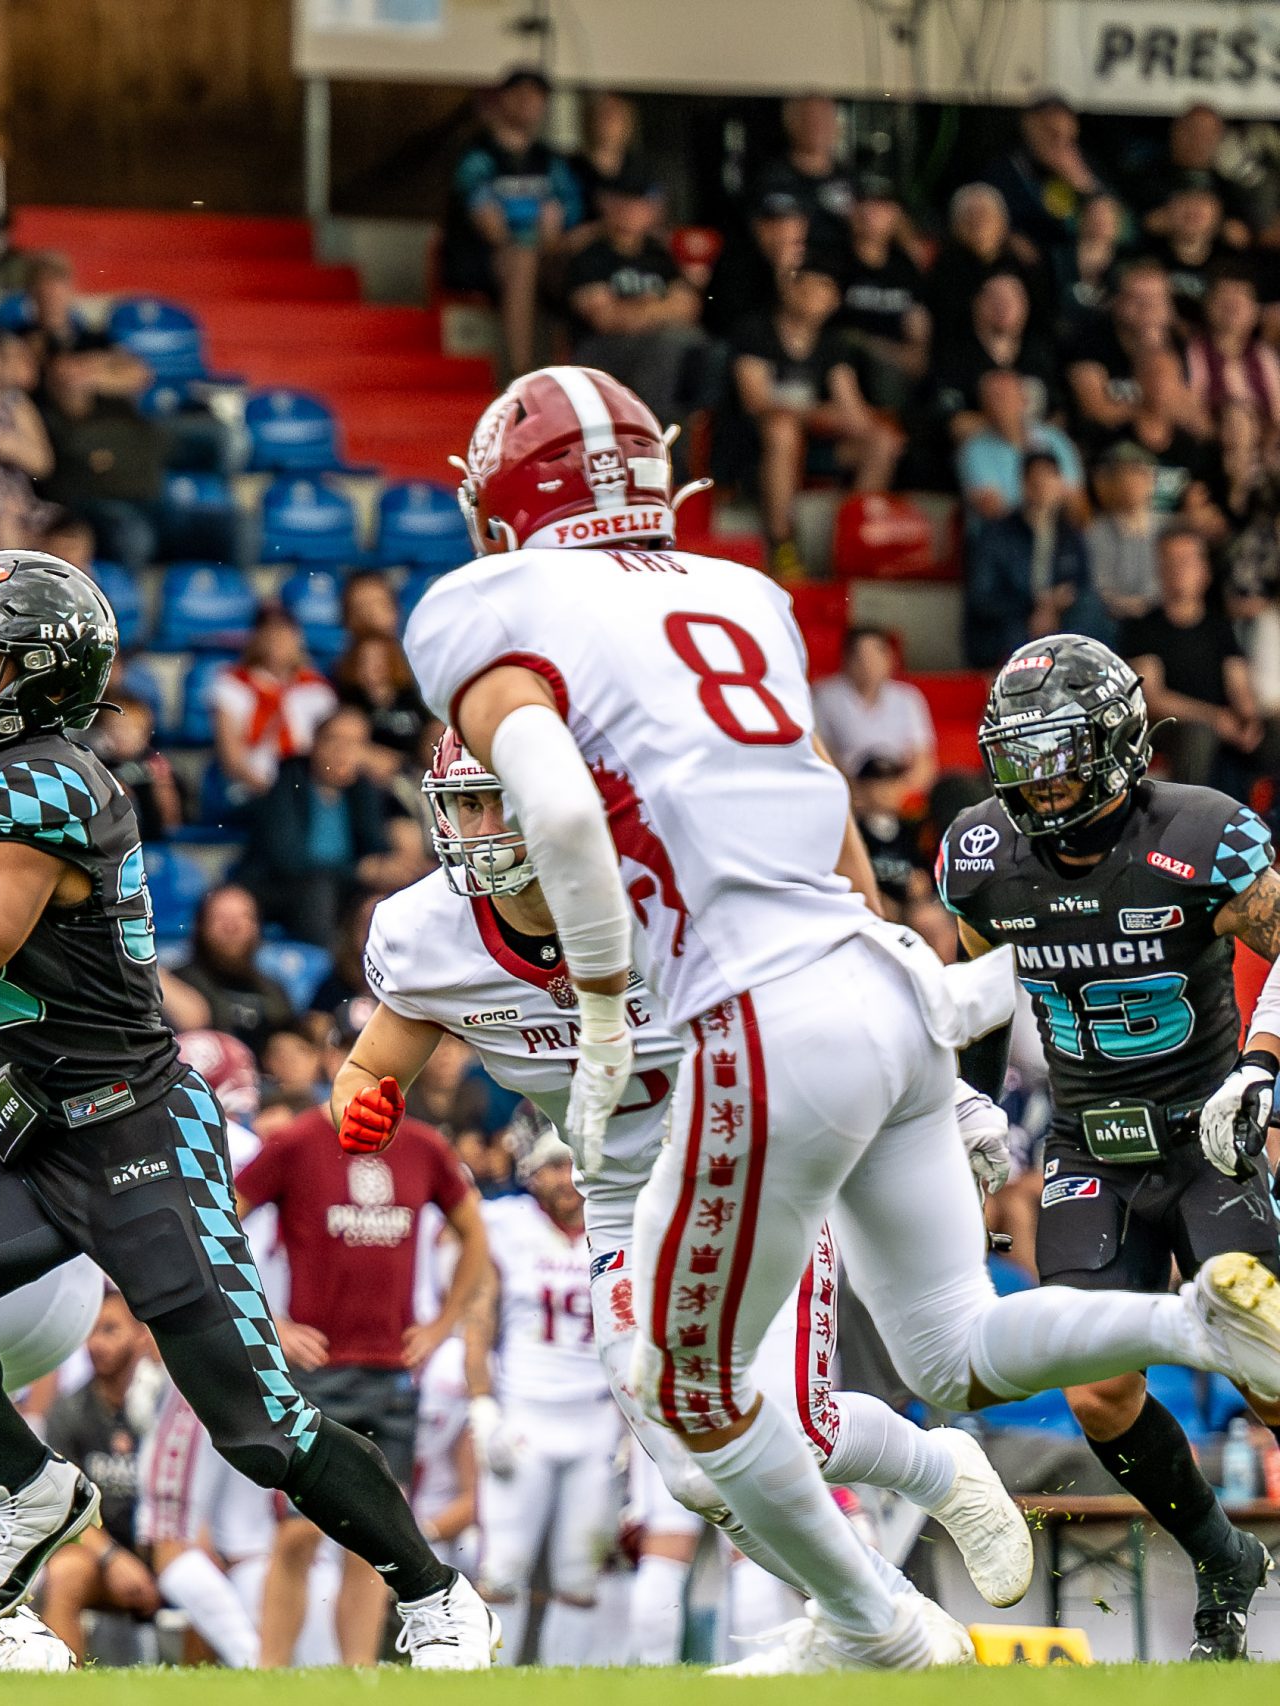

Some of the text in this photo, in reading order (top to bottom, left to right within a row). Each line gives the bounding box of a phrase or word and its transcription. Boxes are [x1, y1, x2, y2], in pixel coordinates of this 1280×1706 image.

[1096, 26, 1280, 84] PRES
[555, 511, 663, 545] FORELLE
[663, 611, 805, 747] 8
[954, 858, 996, 872] TOYOTA
[1150, 853, 1193, 879] GAZI
[1050, 897, 1100, 914] RAVENS
[1017, 938, 1165, 971] MUNICH
[520, 998, 652, 1054] PRAE
[1018, 972, 1195, 1061] 13
[1095, 1120, 1147, 1142] RAVENS
[112, 1160, 169, 1185] RAVENS
